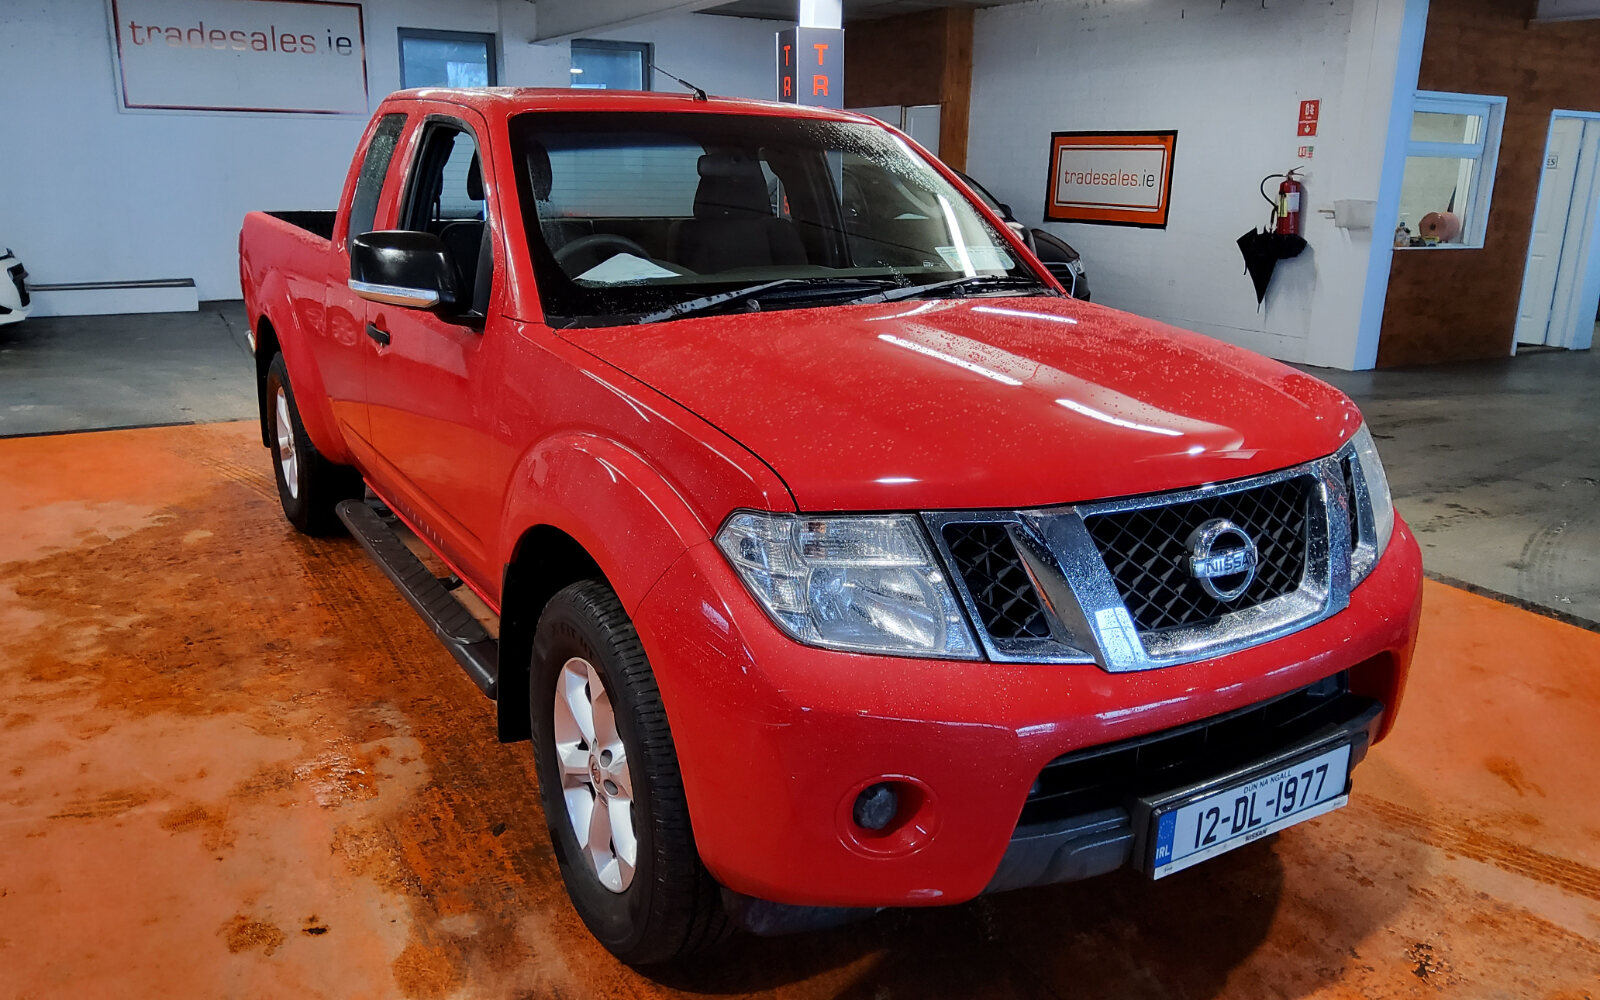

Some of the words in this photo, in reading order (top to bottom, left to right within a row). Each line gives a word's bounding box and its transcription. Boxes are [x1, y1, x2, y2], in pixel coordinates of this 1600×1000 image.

[128, 20, 353, 57] tradesales.ie
[813, 43, 829, 108] TR
[1064, 168, 1155, 188] tradesales.ie
[1259, 779, 1269, 788] NA
[1270, 770, 1292, 783] NGALL
[1194, 763, 1329, 850] 12-DL-1977
[1155, 844, 1170, 860] IRL
